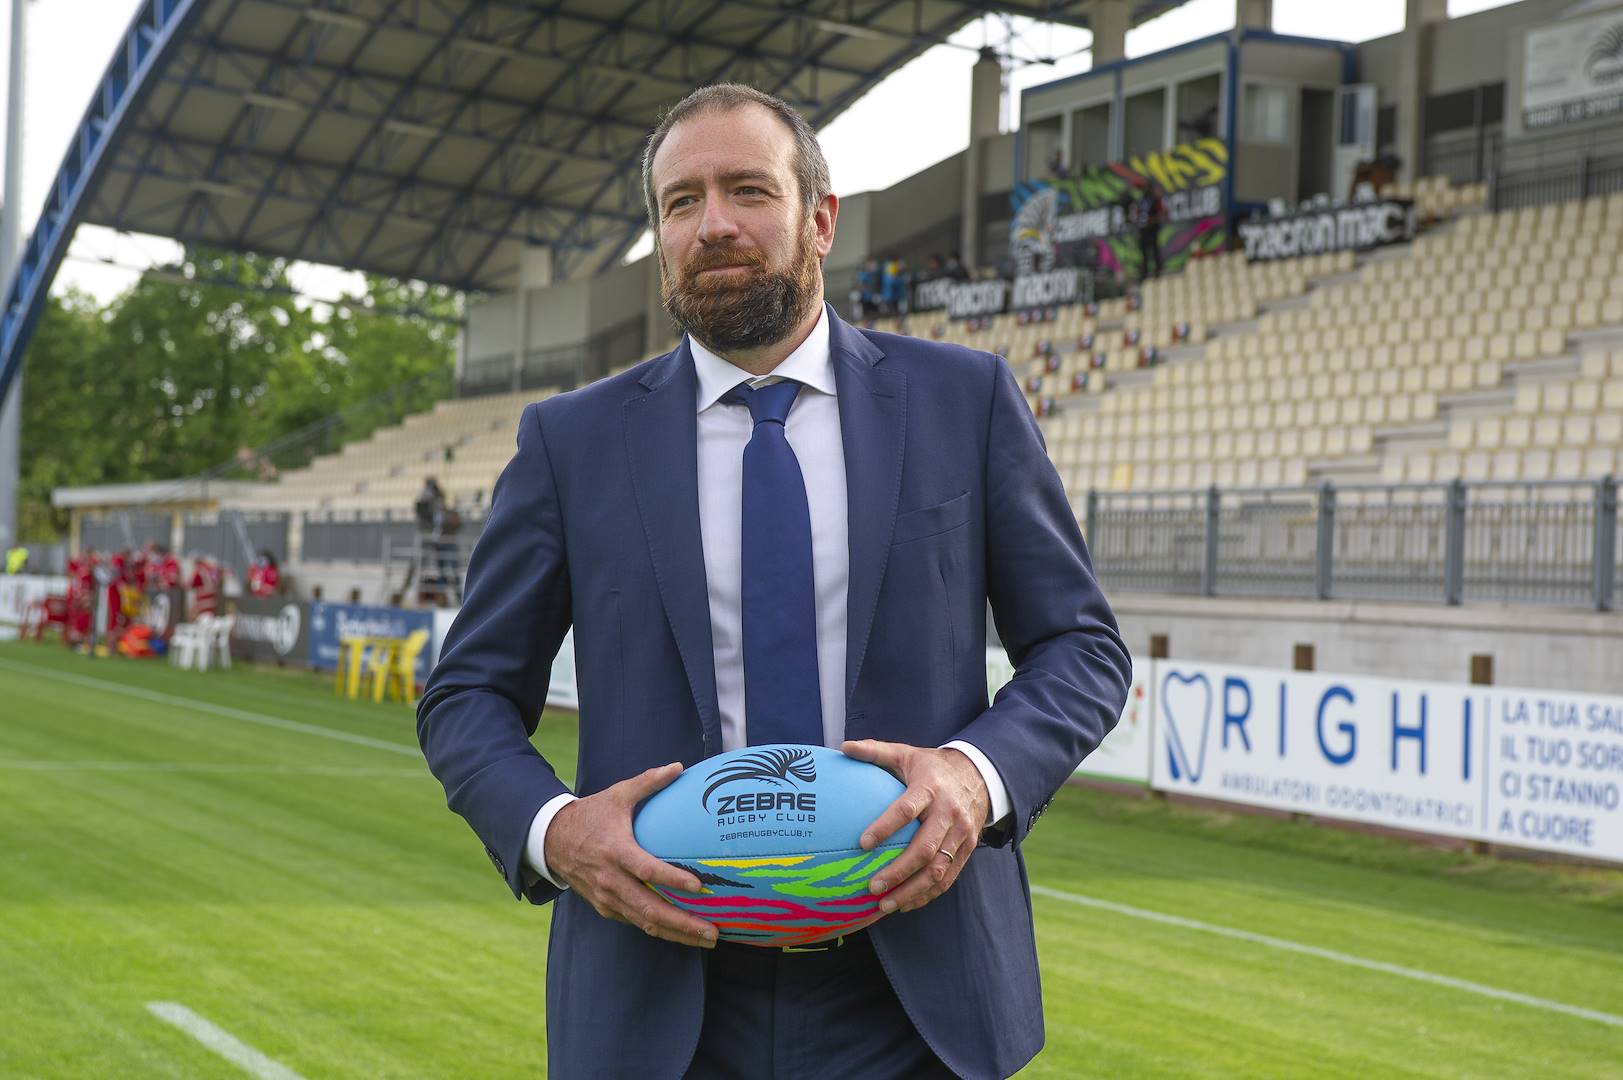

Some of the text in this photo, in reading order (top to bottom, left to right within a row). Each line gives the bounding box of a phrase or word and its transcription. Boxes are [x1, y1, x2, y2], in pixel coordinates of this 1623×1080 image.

[1222, 676, 1472, 781] RIGHI
[1502, 698, 1529, 724] LA
[1537, 700, 1581, 729] TUA
[1502, 735, 1518, 761] IL
[1528, 737, 1572, 766] TUO
[717, 792, 816, 815] ZEBRE
[1221, 771, 1473, 826] AMBULATORI ODONTOIATRICI
[1500, 772, 1619, 811] CI STANNO
[717, 813, 816, 827] RUGBY CLUB
[720, 830, 813, 841] ZEBRERUGBYCLUB.IT
[1500, 809, 1594, 846] A CUORE
